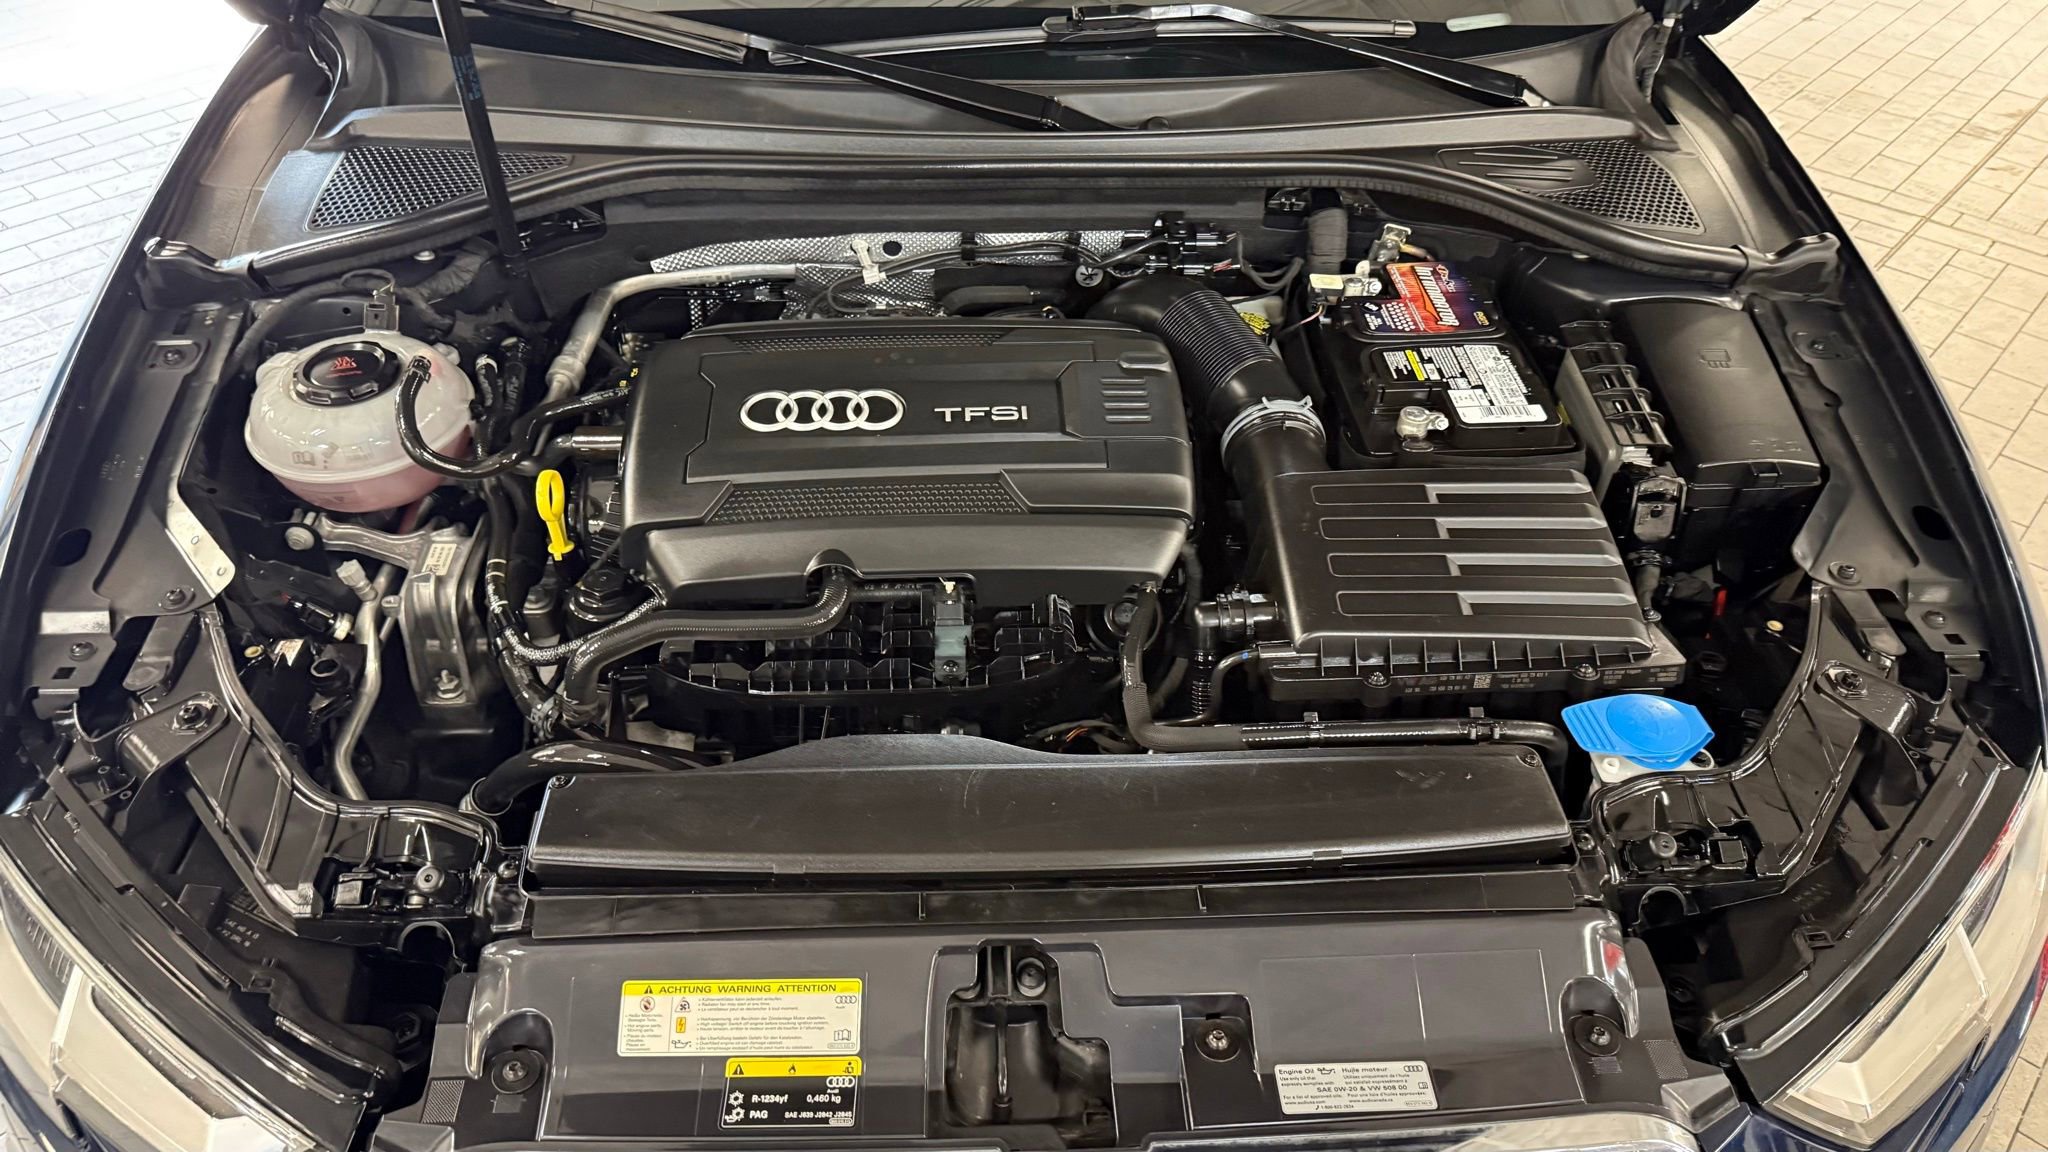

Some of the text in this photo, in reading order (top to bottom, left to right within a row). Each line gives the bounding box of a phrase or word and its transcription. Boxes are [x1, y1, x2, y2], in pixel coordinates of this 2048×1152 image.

[934, 405, 1028, 422] TFSI
[659, 983, 837, 994] ACHTUNG WARNING ATTENTION
[751, 1094, 842, 1105] R-1234yf 0,460 kg
[749, 1110, 769, 1119] PAG
